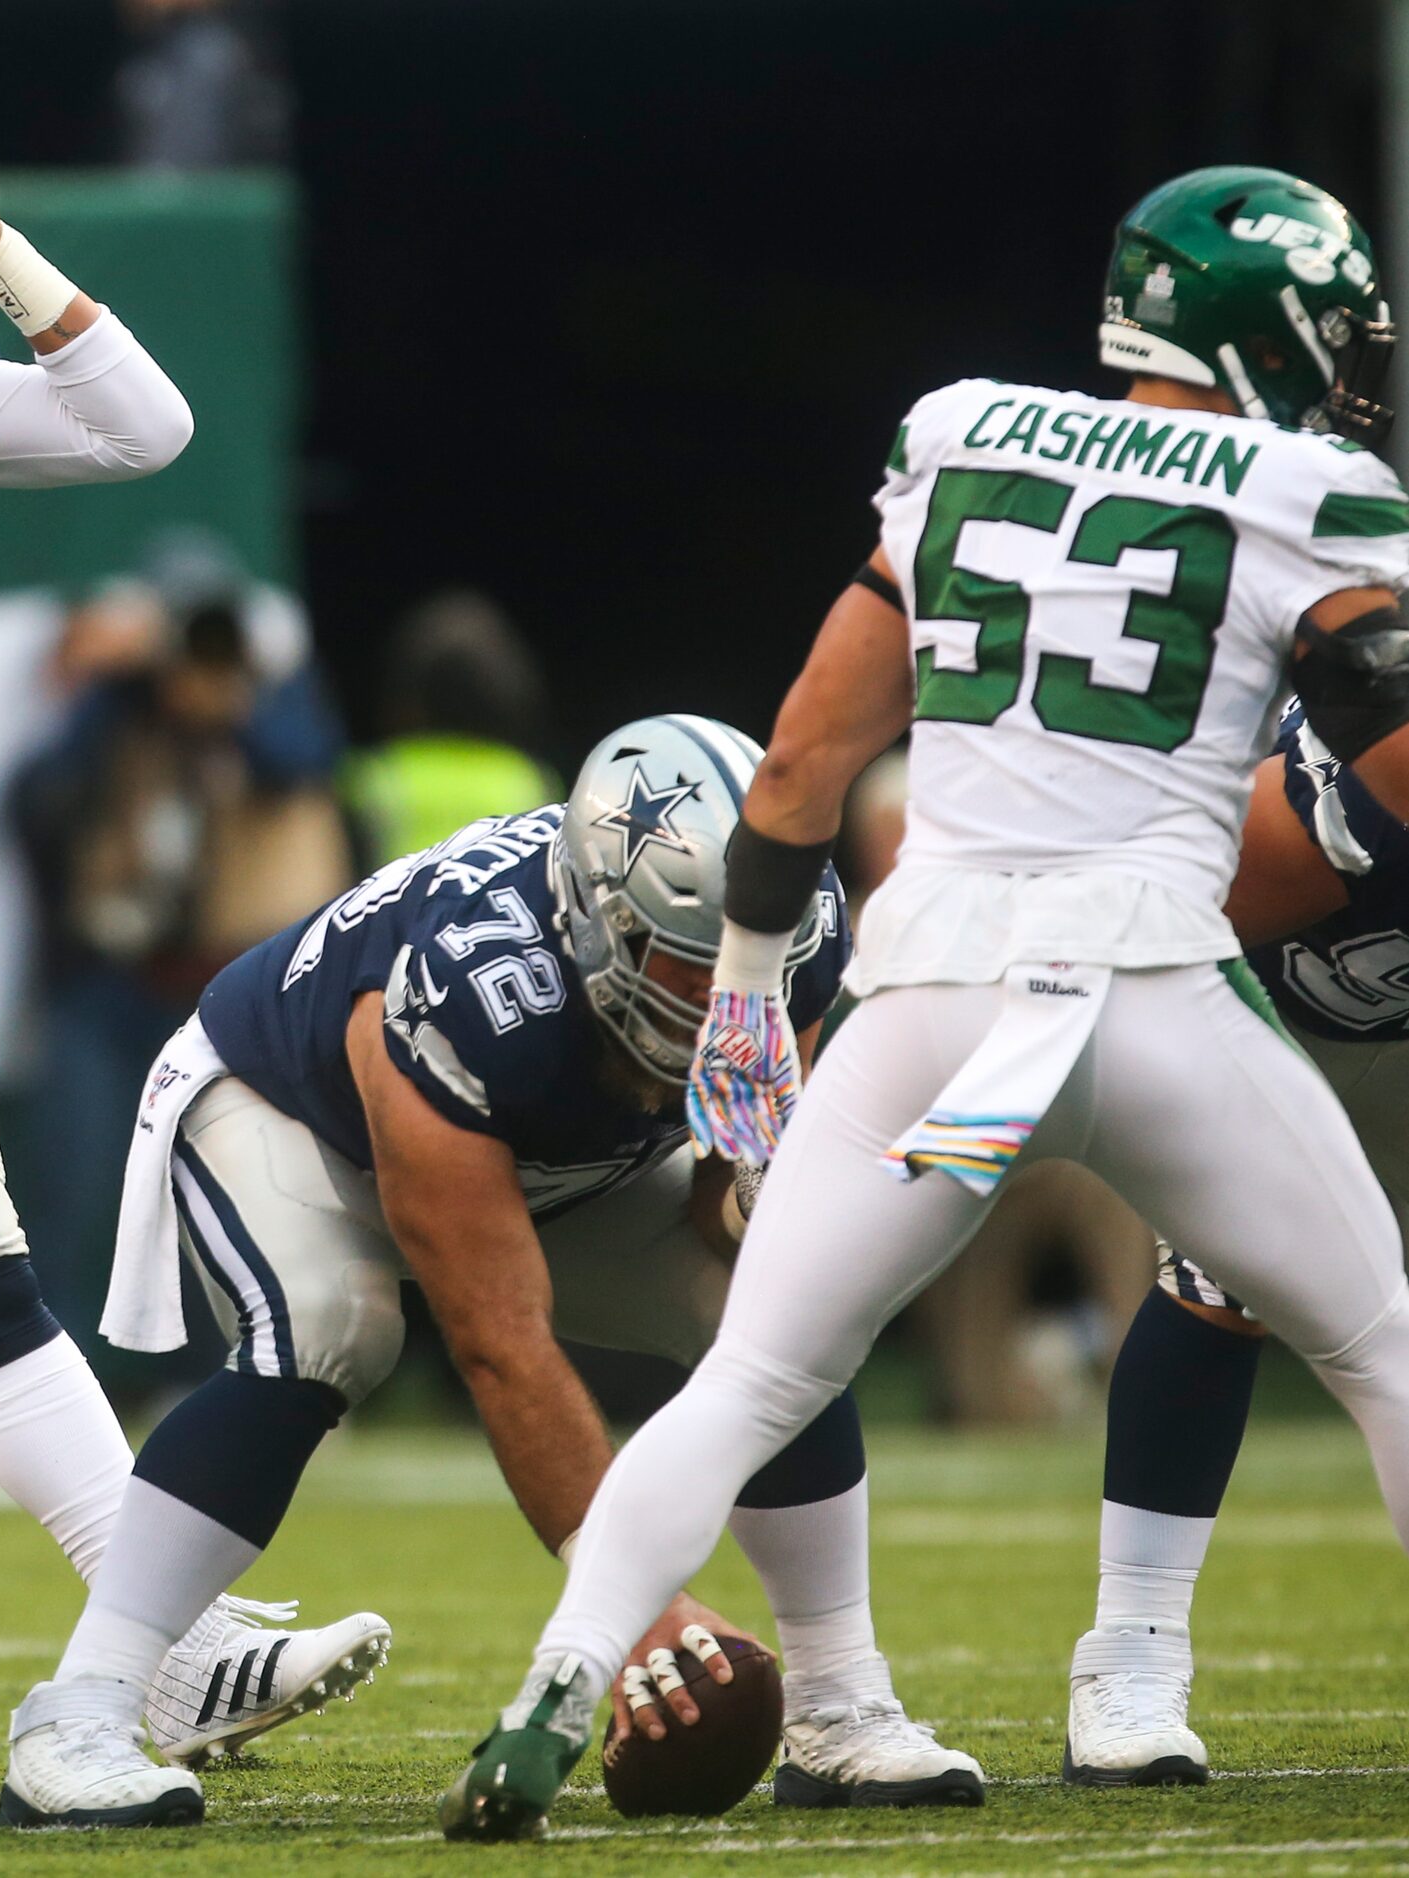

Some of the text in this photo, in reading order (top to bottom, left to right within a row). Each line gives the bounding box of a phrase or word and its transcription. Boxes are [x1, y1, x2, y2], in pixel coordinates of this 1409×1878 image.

[963, 399, 1260, 497] CASHMAN
[912, 467, 1239, 755] 53
[434, 885, 567, 1036] 72
[1027, 978, 1090, 998] Wilson
[719, 1028, 758, 1068] NFL
